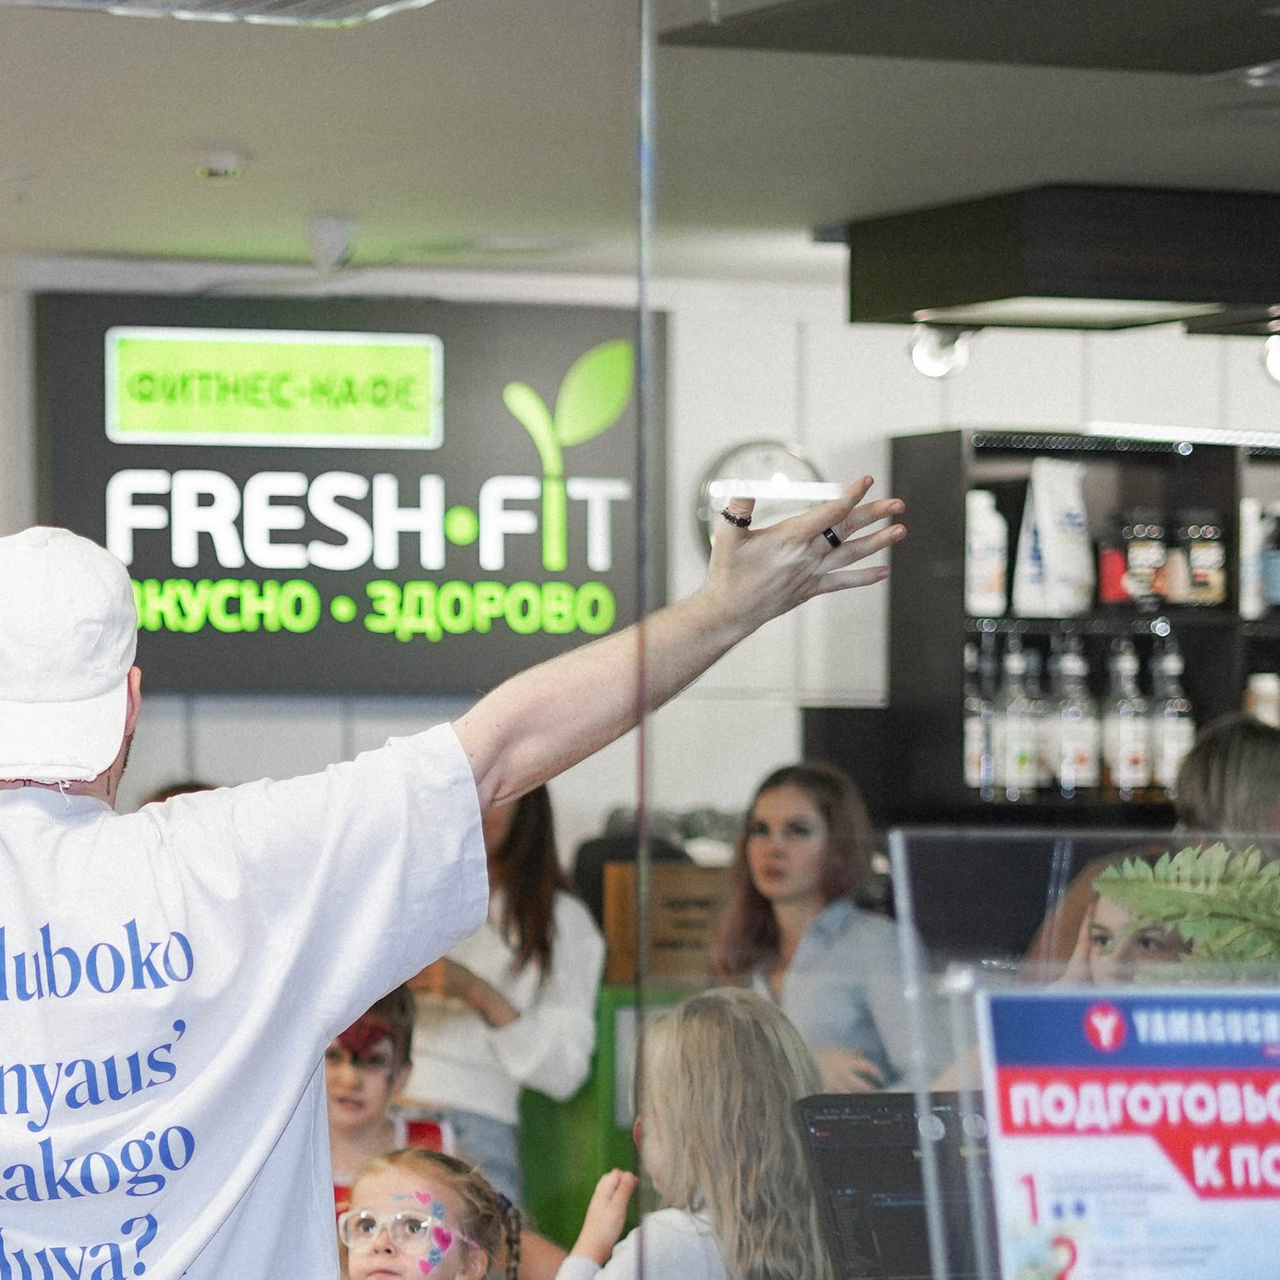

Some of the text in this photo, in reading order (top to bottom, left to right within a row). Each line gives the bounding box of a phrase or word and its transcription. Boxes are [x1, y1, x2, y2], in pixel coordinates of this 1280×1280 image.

[132, 579, 616, 642] КУСНО ЗДОРОВО
[1192, 1144, 1225, 1188] К
[1019, 1174, 1038, 1226] 1
